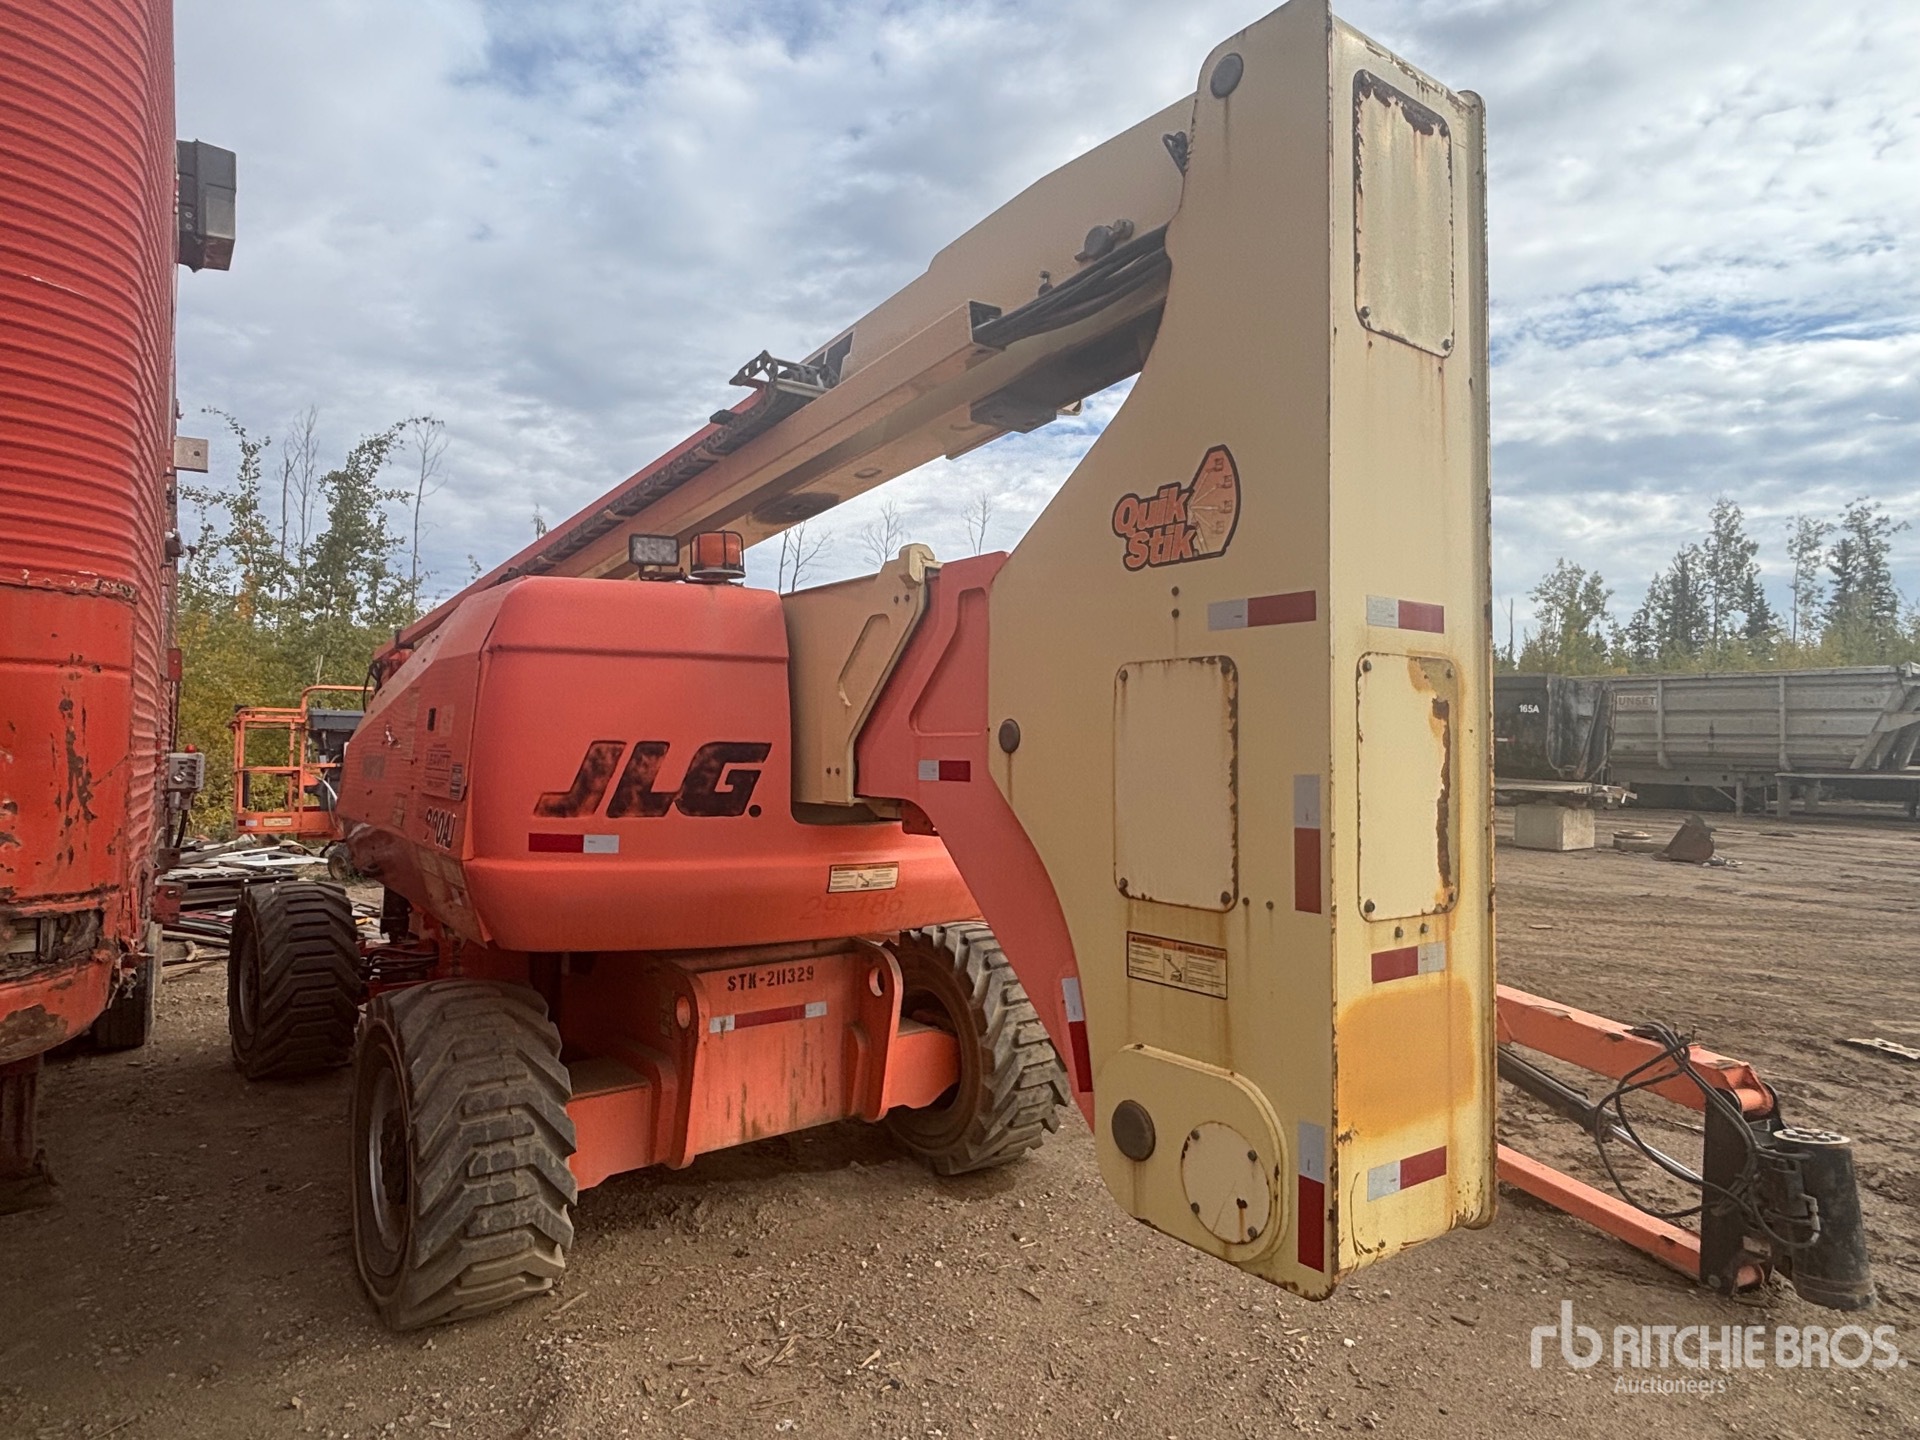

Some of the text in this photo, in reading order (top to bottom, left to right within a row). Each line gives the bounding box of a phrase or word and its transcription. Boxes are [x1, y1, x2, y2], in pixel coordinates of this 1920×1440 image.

[1113, 484, 1190, 538] Quik
[1125, 522, 1197, 569] Stik
[1518, 704, 1540, 714] 165A
